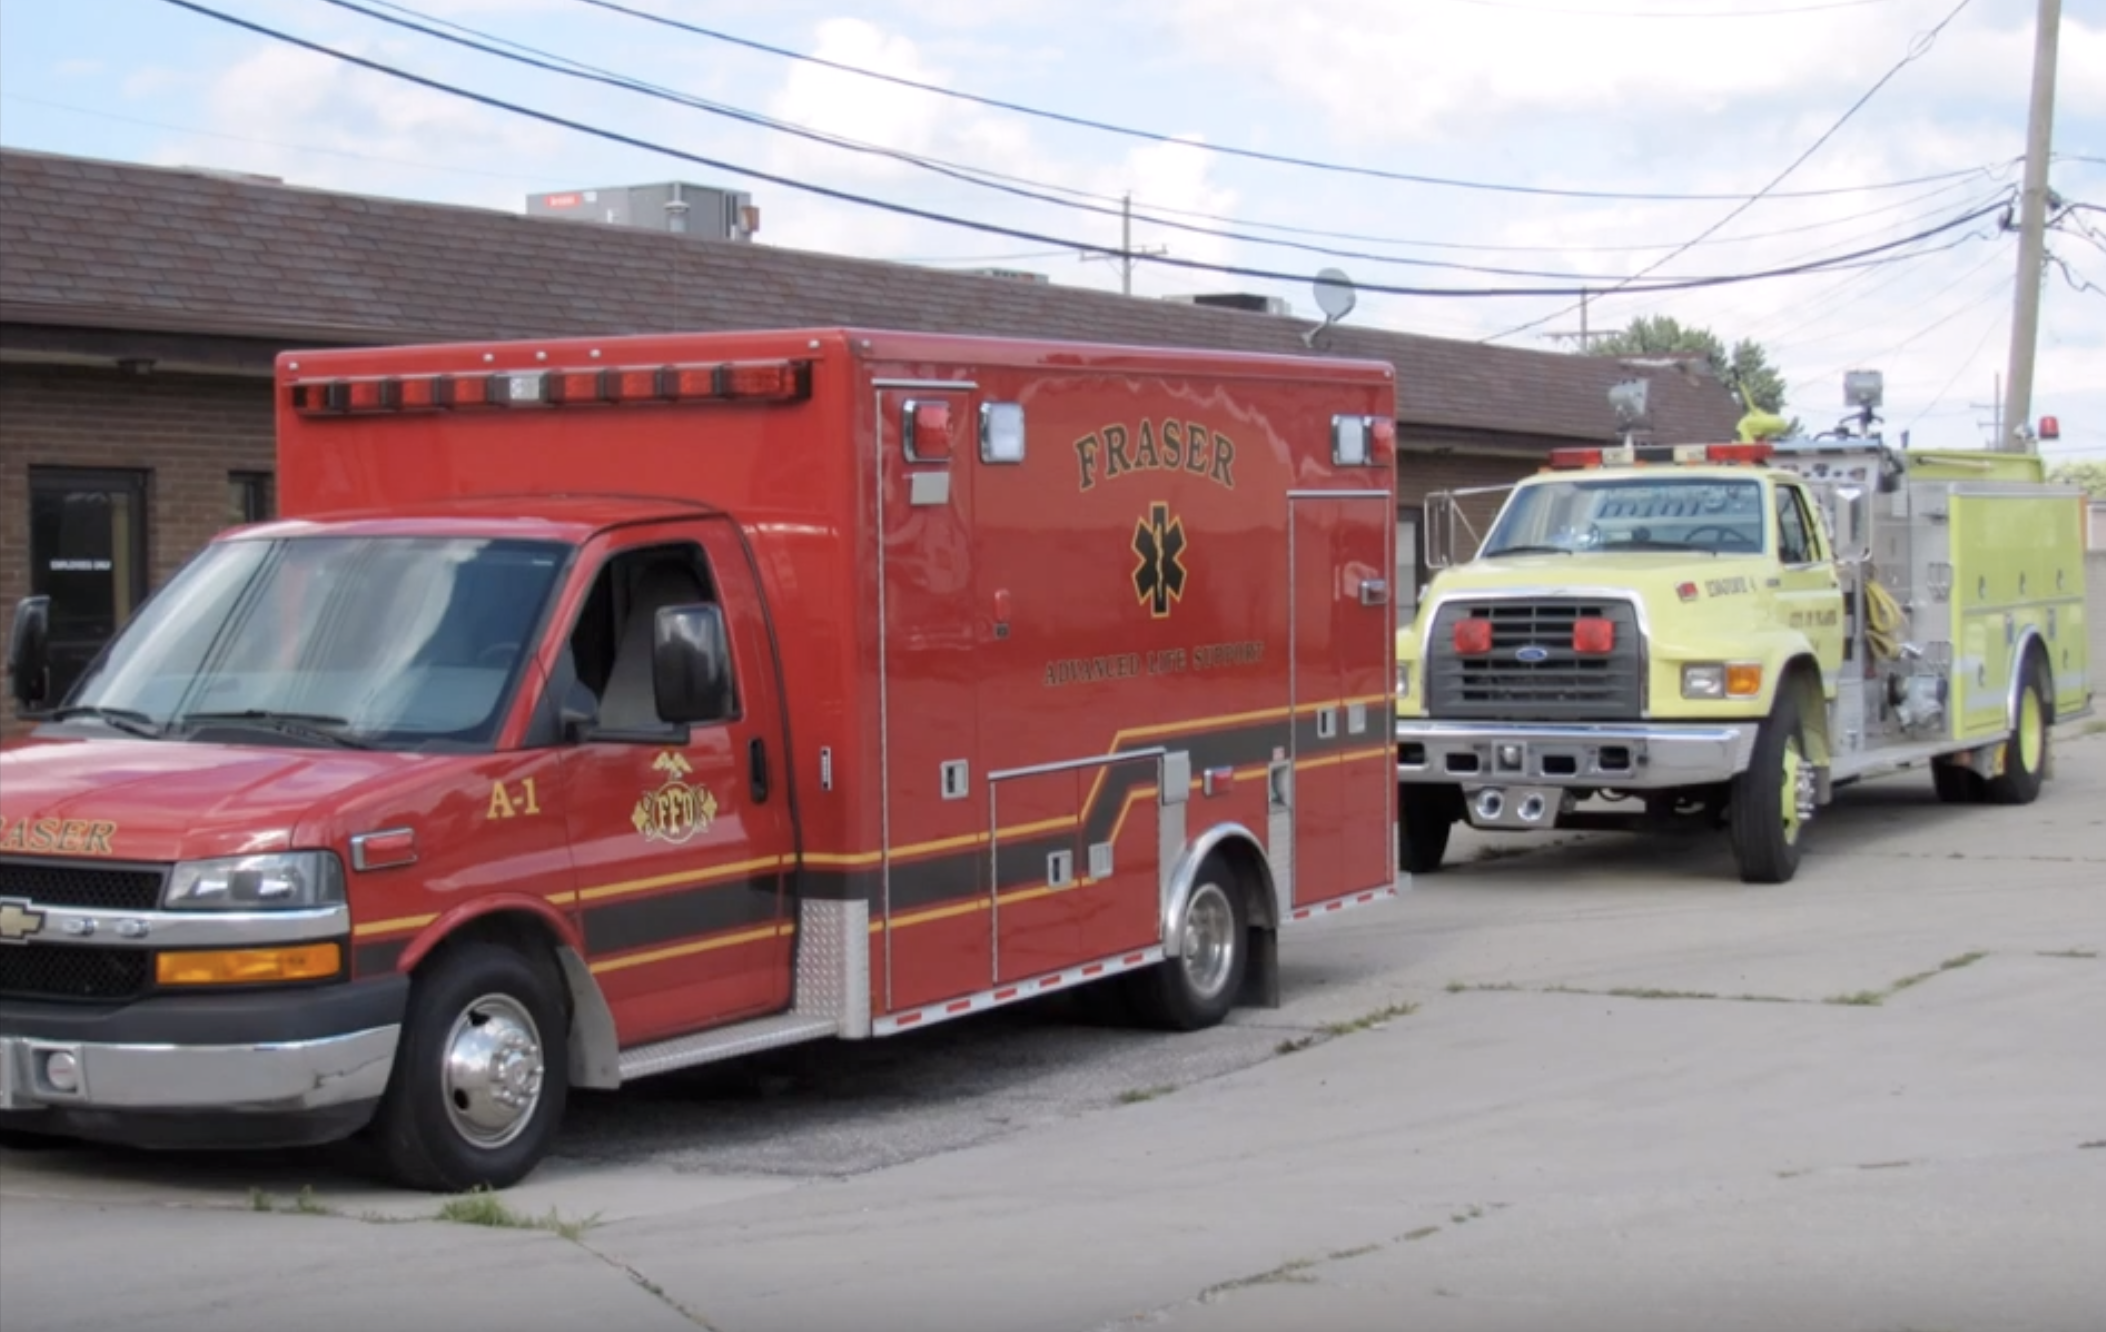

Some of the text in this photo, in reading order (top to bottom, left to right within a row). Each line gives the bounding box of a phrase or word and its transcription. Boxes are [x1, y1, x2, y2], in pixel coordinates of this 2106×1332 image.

[1074, 417, 1235, 491] FRASER
[1044, 641, 1264, 687] ADVANCED LIFE SUPPORT
[486, 777, 540, 819] A-1
[0, 814, 117, 854] ASER
